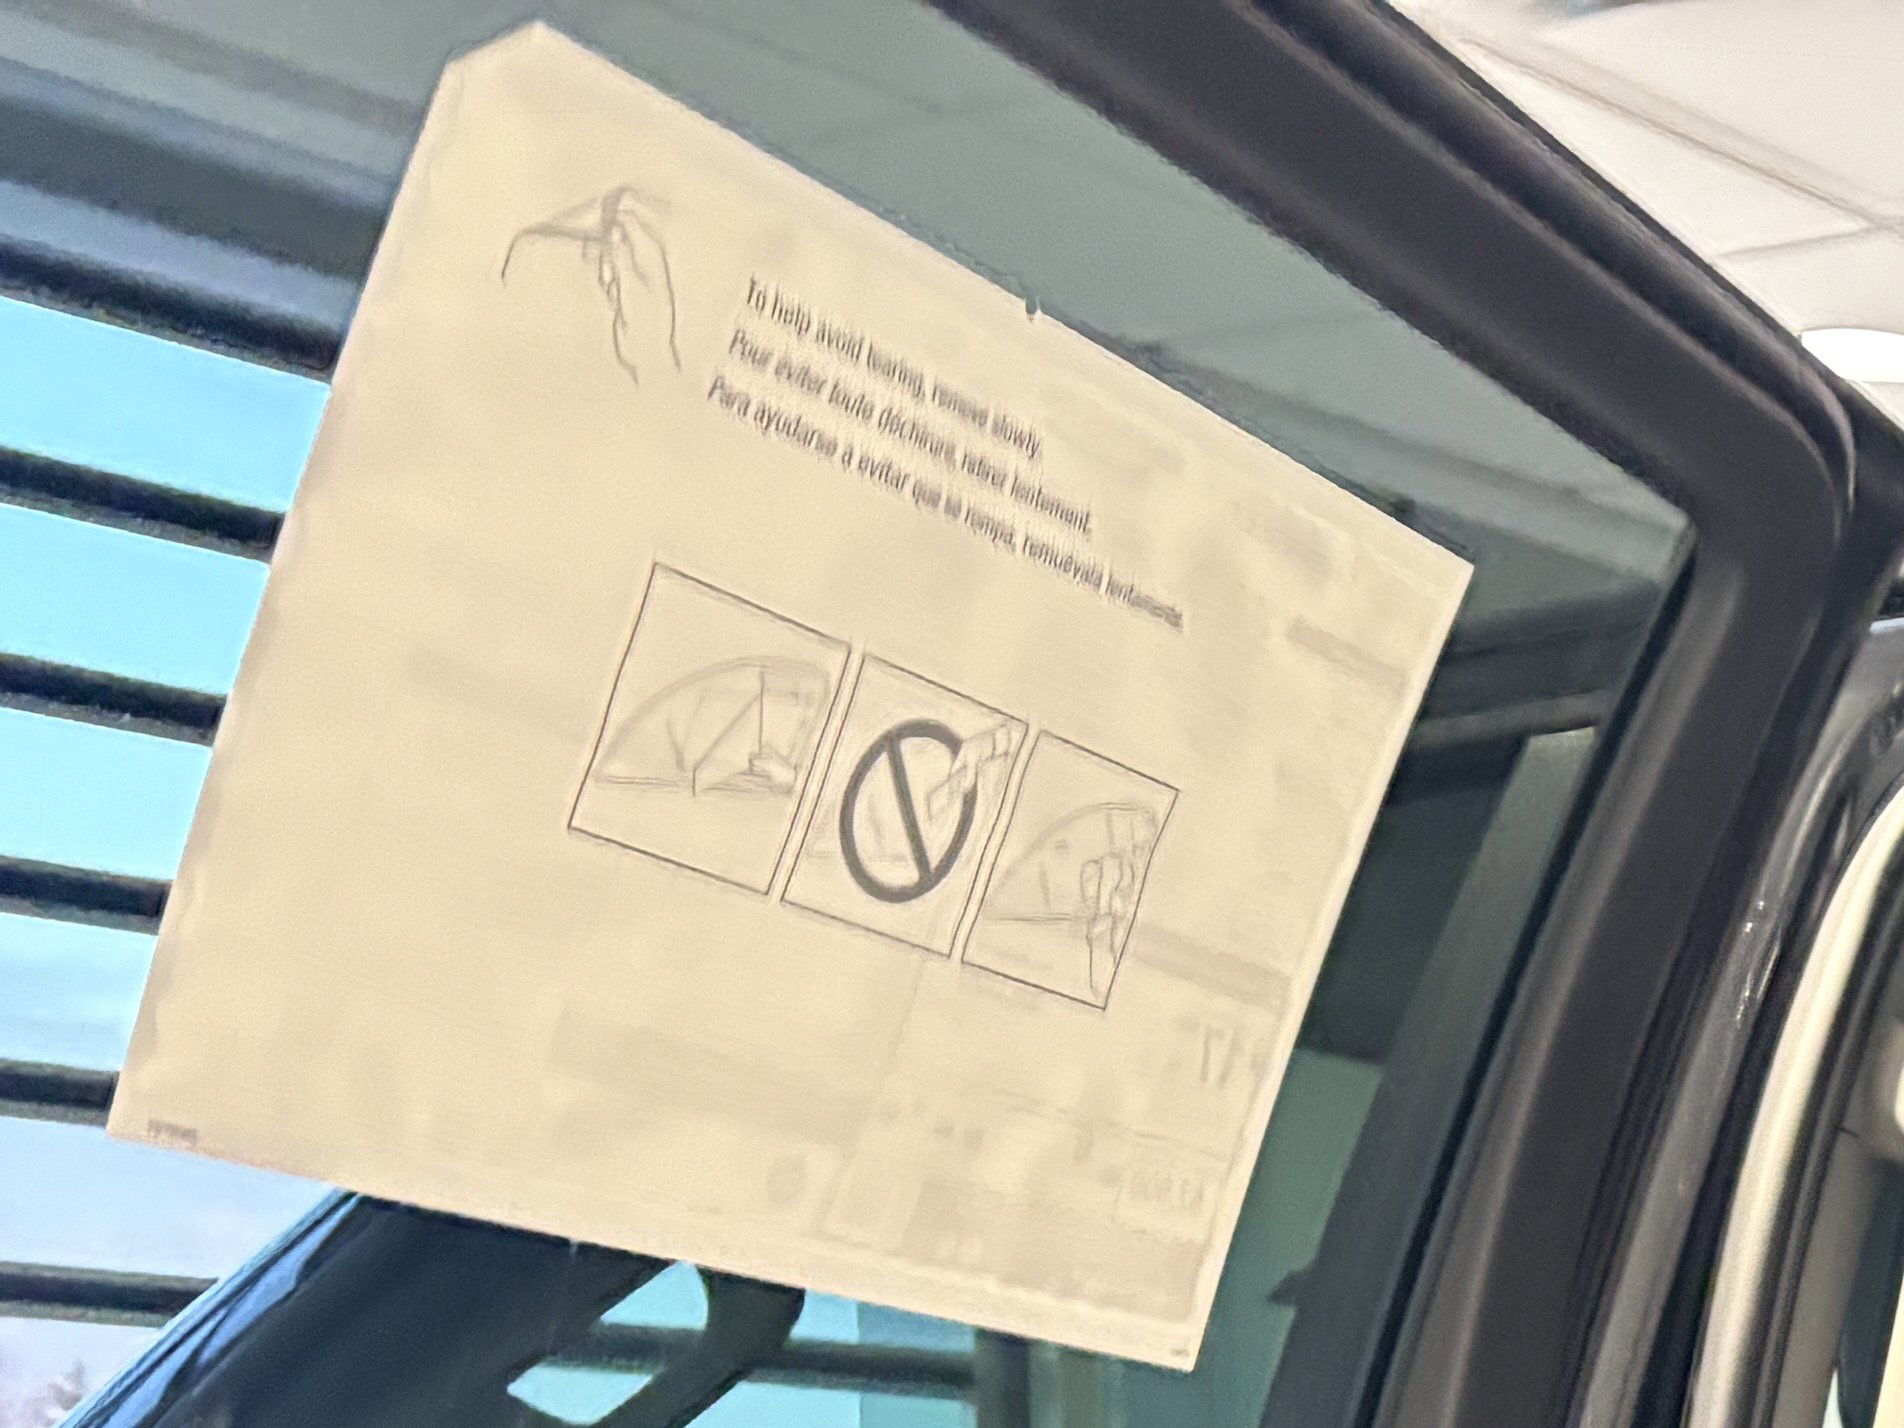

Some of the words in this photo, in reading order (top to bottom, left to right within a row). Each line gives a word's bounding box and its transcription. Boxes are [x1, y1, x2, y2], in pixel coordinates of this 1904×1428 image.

[747, 274, 766, 312] To
[771, 285, 812, 335] help
[815, 317, 865, 363] avoid
[729, 328, 774, 370] Pour
[708, 374, 750, 418] Para
